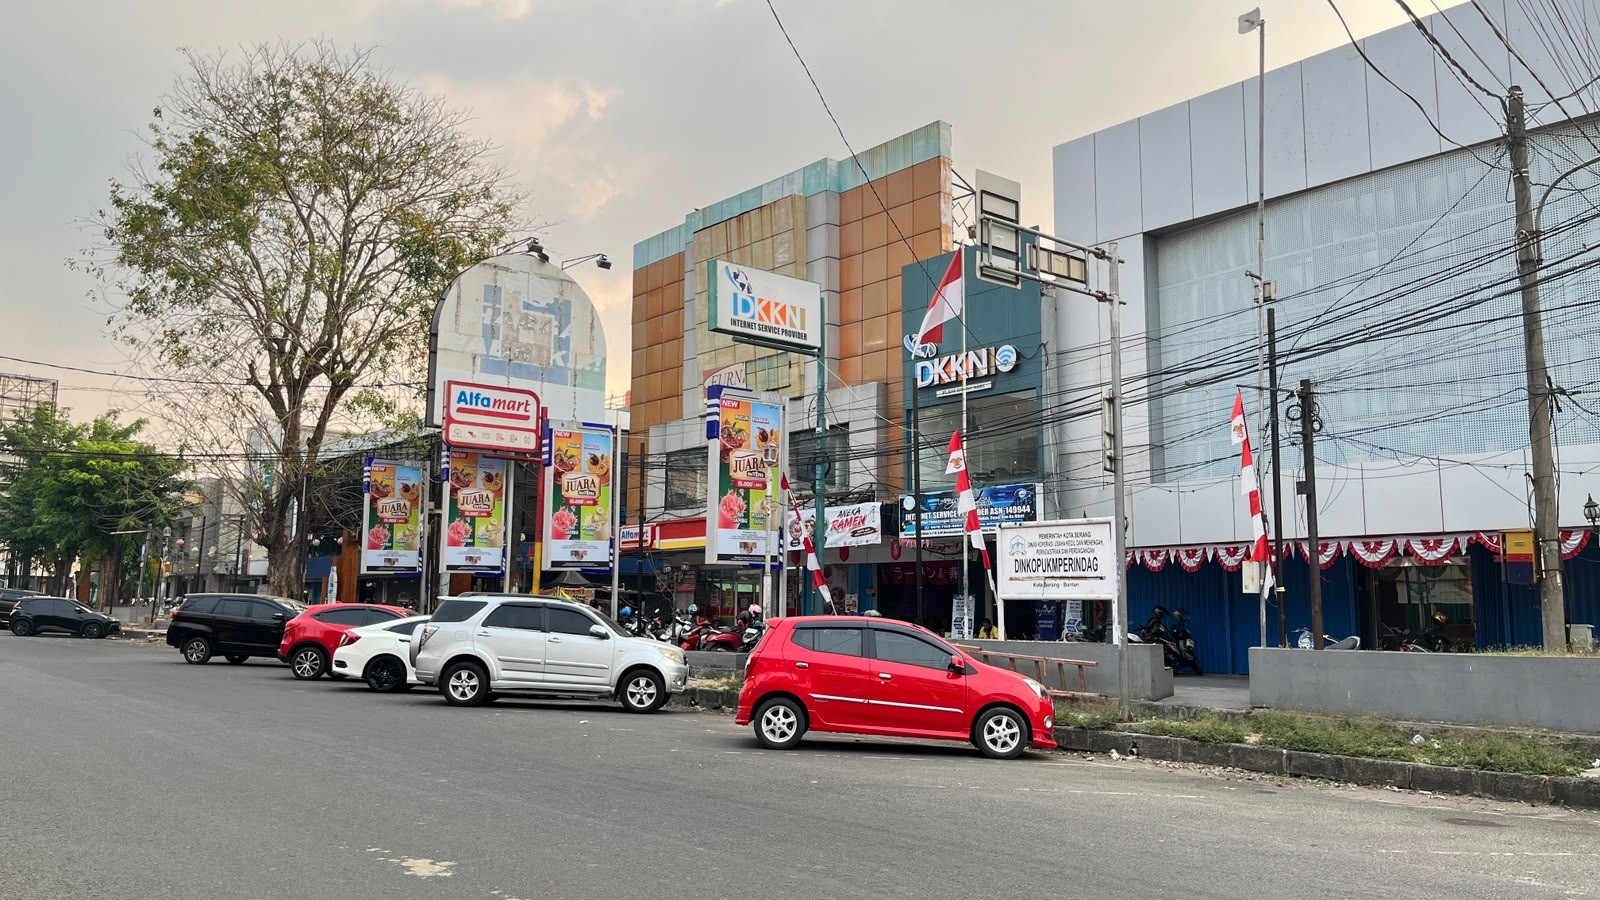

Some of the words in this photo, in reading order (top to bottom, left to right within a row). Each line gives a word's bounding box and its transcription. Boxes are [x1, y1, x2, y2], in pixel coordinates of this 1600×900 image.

[730, 318, 757, 331] INTERNET
[757, 323, 781, 336] SERVICE
[781, 328, 808, 341] PROVIDER
[722, 400, 739, 408] NEW
[733, 457, 766, 473] JUARA
[565, 479, 596, 492] JUARA
[461, 494, 491, 506] JUARA
[380, 502, 408, 513] JUARA
[837, 507, 861, 519] ANEKA
[905, 512, 932, 521] INTNET
[933, 510, 957, 519] SERVICE
[830, 515, 867, 531] RAMEN
[621, 529, 649, 540] Alfamrt
[1014, 556, 1099, 573] DINKOPUKMPERINDAG
